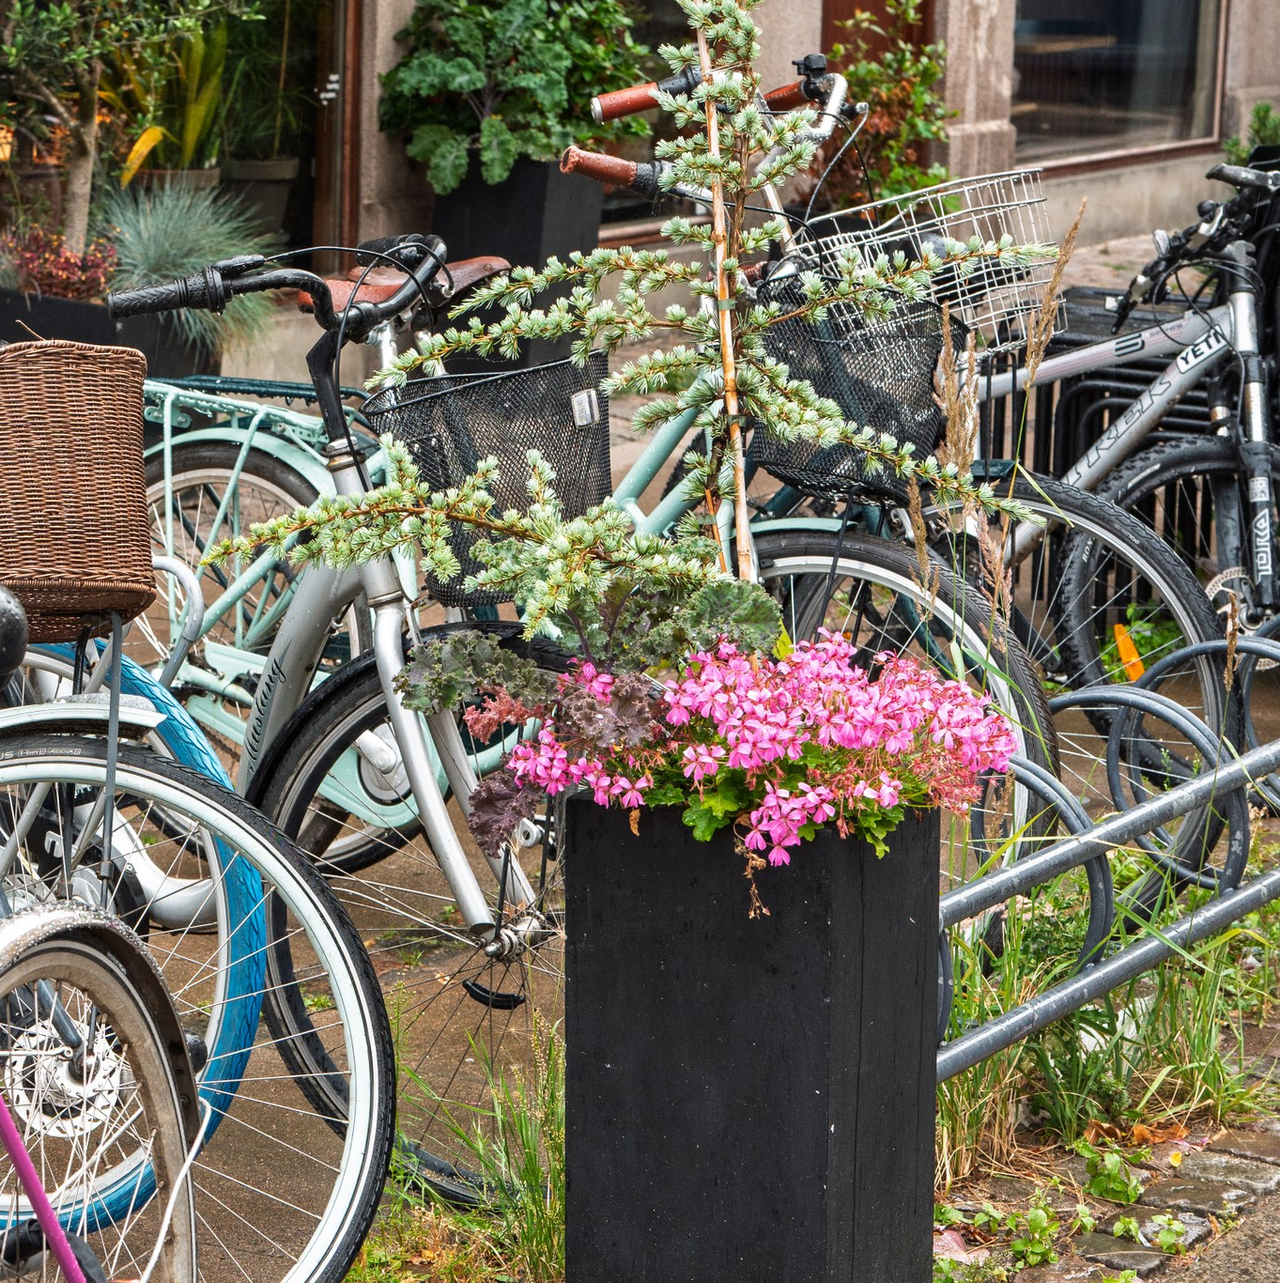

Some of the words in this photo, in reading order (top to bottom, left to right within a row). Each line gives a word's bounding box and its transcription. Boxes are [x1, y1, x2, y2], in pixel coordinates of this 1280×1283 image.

[1180, 331, 1223, 366] YETI
[1061, 376, 1171, 486] TREK
[245, 656, 286, 773] Mustang
